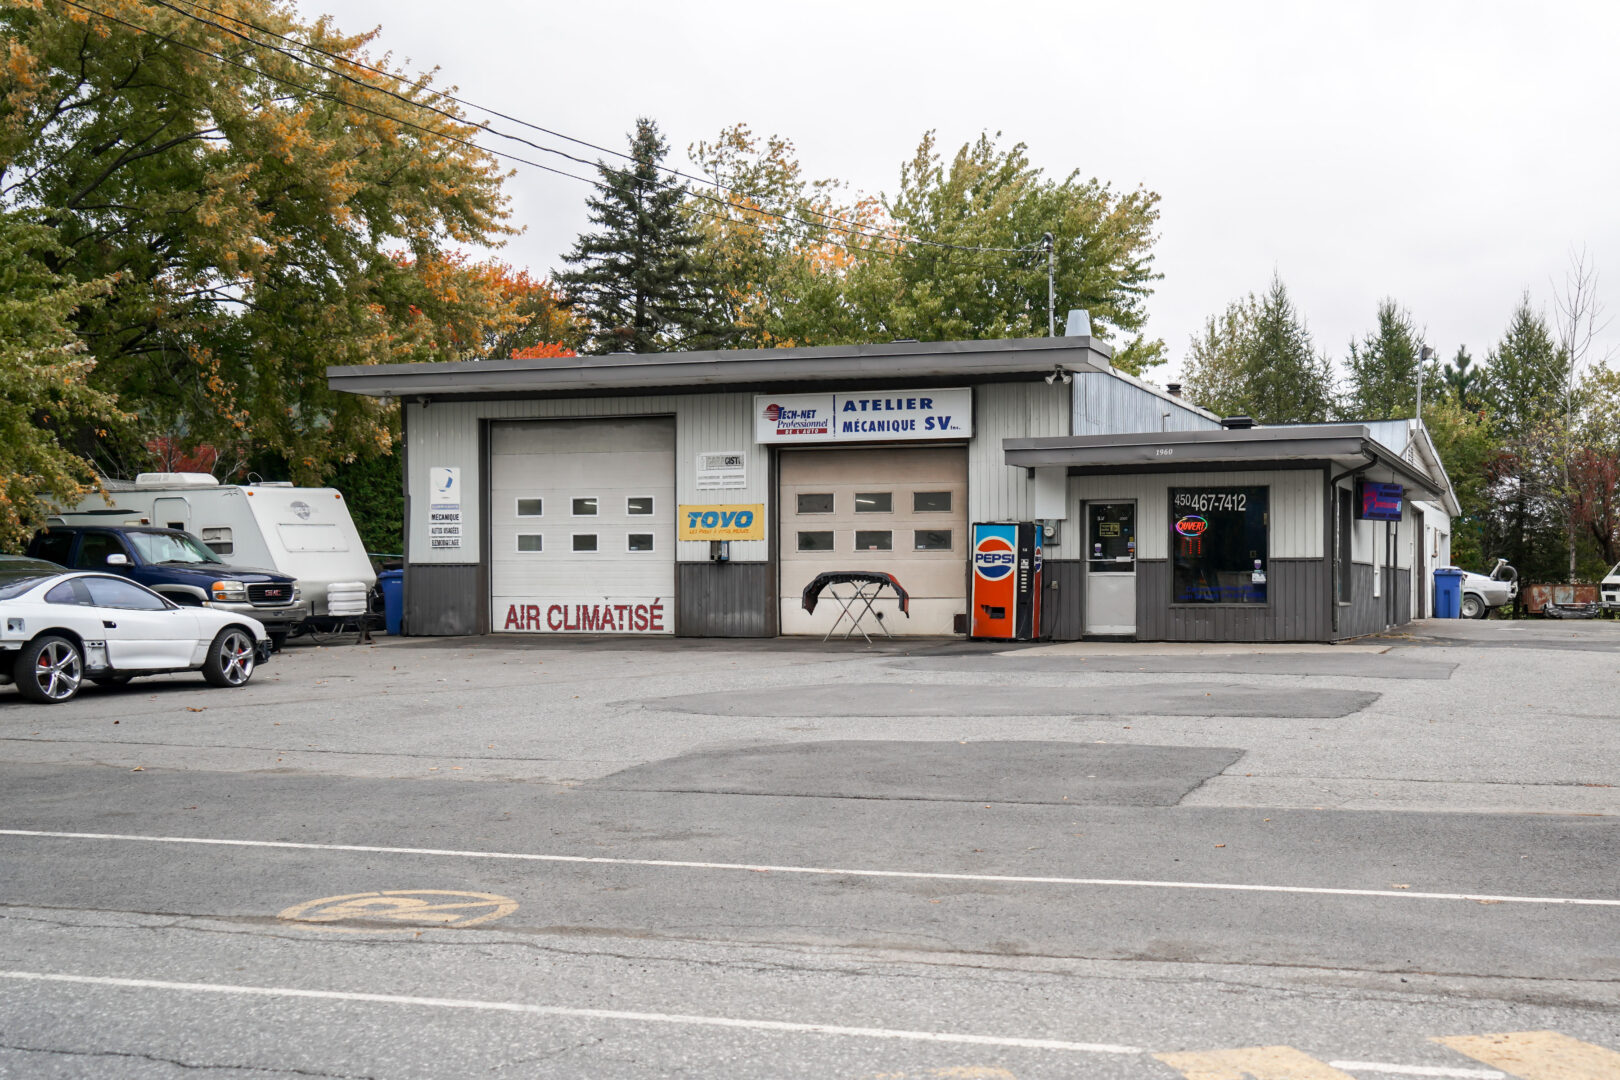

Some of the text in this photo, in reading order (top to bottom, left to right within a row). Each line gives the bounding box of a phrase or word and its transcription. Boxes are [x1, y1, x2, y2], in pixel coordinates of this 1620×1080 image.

[842, 397, 933, 412] ATELIER
[777, 418, 828, 429] Professionnel
[842, 418, 916, 433] MÉCANIQUE
[1156, 448, 1173, 456] 1960
[1174, 493, 1247, 512] 450 467-7412
[687, 510, 754, 529] TOYO
[1177, 520, 1206, 531] OUVERT
[975, 553, 1015, 564] PEPSI
[264, 589, 281, 597] GMC
[504, 597, 664, 631] AIR CLIMATISÉ
